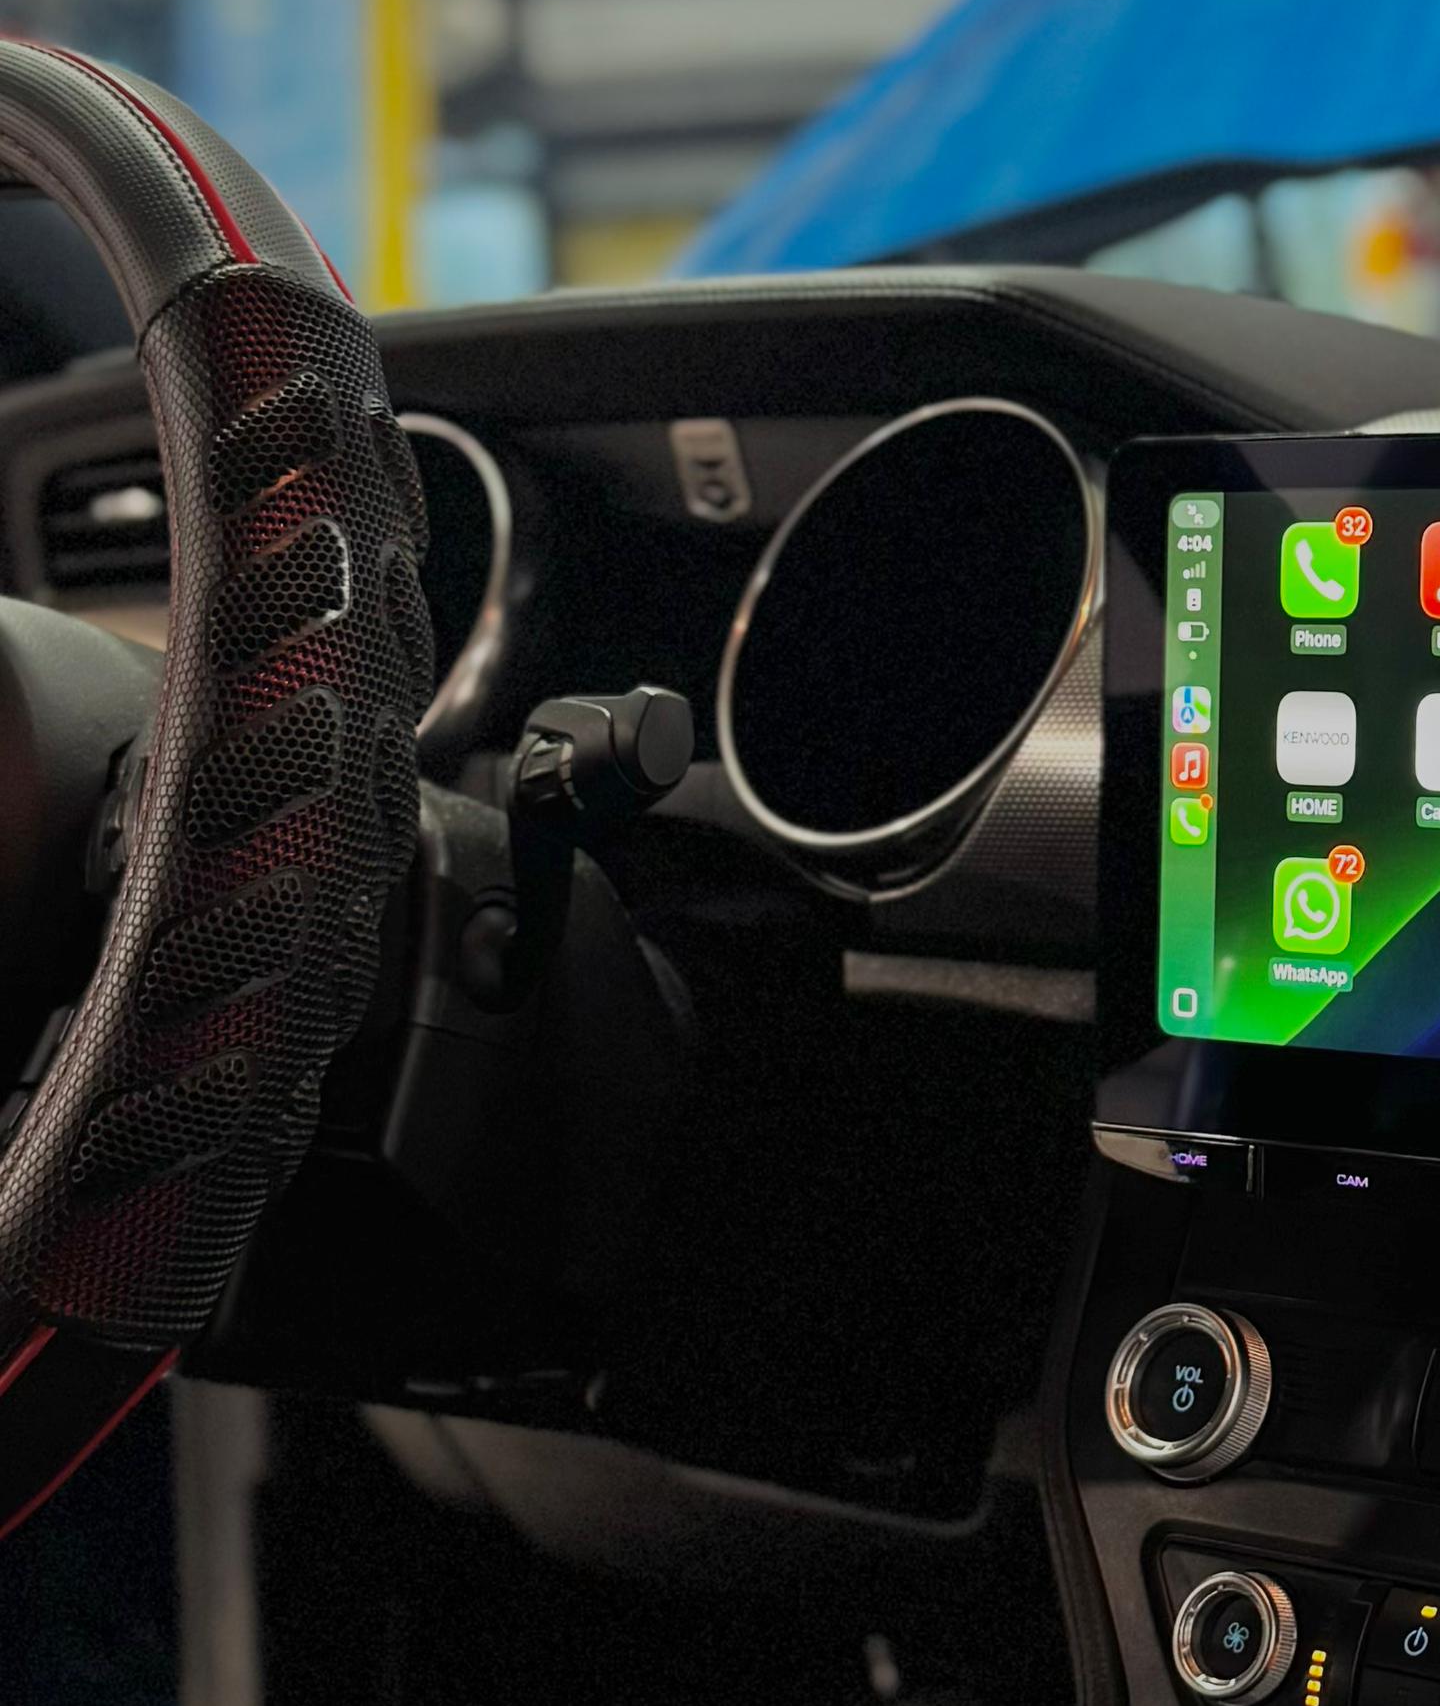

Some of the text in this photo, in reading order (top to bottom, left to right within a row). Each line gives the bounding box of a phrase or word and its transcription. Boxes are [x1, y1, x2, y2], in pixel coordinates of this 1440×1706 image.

[1342, 516, 1367, 537] 32
[1178, 534, 1213, 551] 4:04
[1295, 630, 1342, 650] Phone
[1284, 731, 1349, 746] KENWOOD
[1291, 797, 1337, 817] HOME
[1334, 855, 1358, 876] 72
[1272, 963, 1348, 988] WhatsApp
[1336, 1174, 1369, 1188] CAM
[1175, 1366, 1204, 1383] VOL
